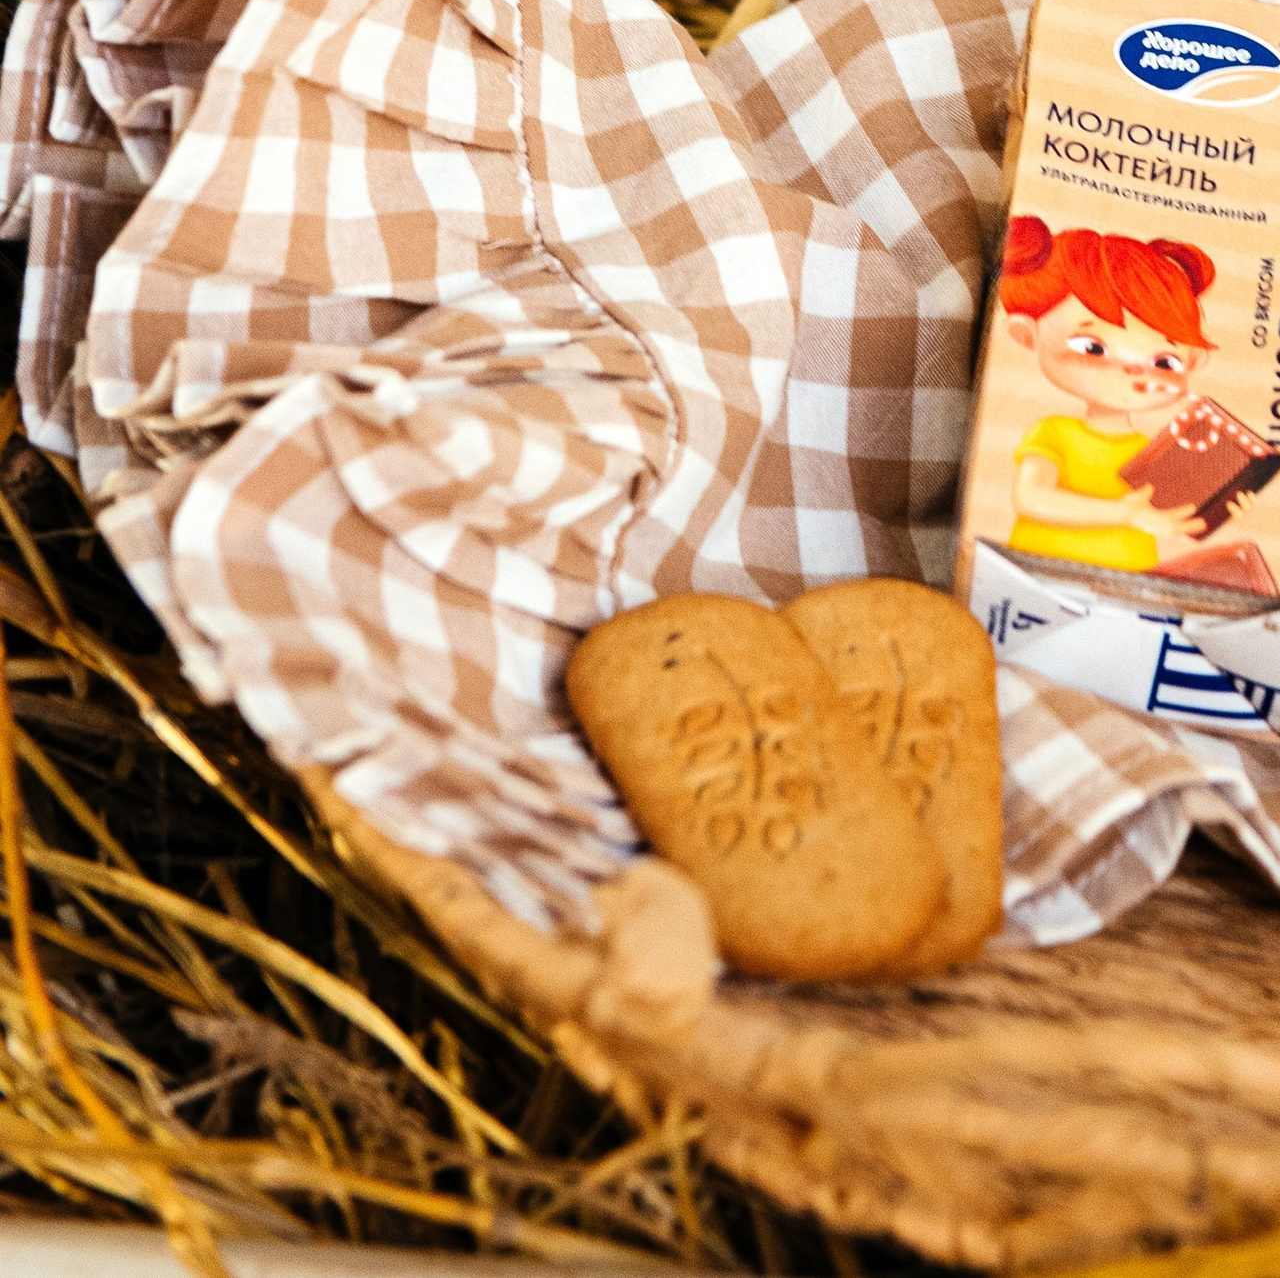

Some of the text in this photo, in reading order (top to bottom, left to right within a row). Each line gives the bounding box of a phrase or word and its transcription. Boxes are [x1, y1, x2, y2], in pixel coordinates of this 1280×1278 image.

[1139, 51, 1201, 74] дело
[1141, 29, 1252, 64] Хорошее
[1047, 101, 1255, 165] МОЛОЧНЫЙ
[1043, 133, 1219, 193] КОКТЕЙЛЬ
[1040, 165, 1268, 224] УЛЬТРАПАСТЕРИЗОВАННЫЙ
